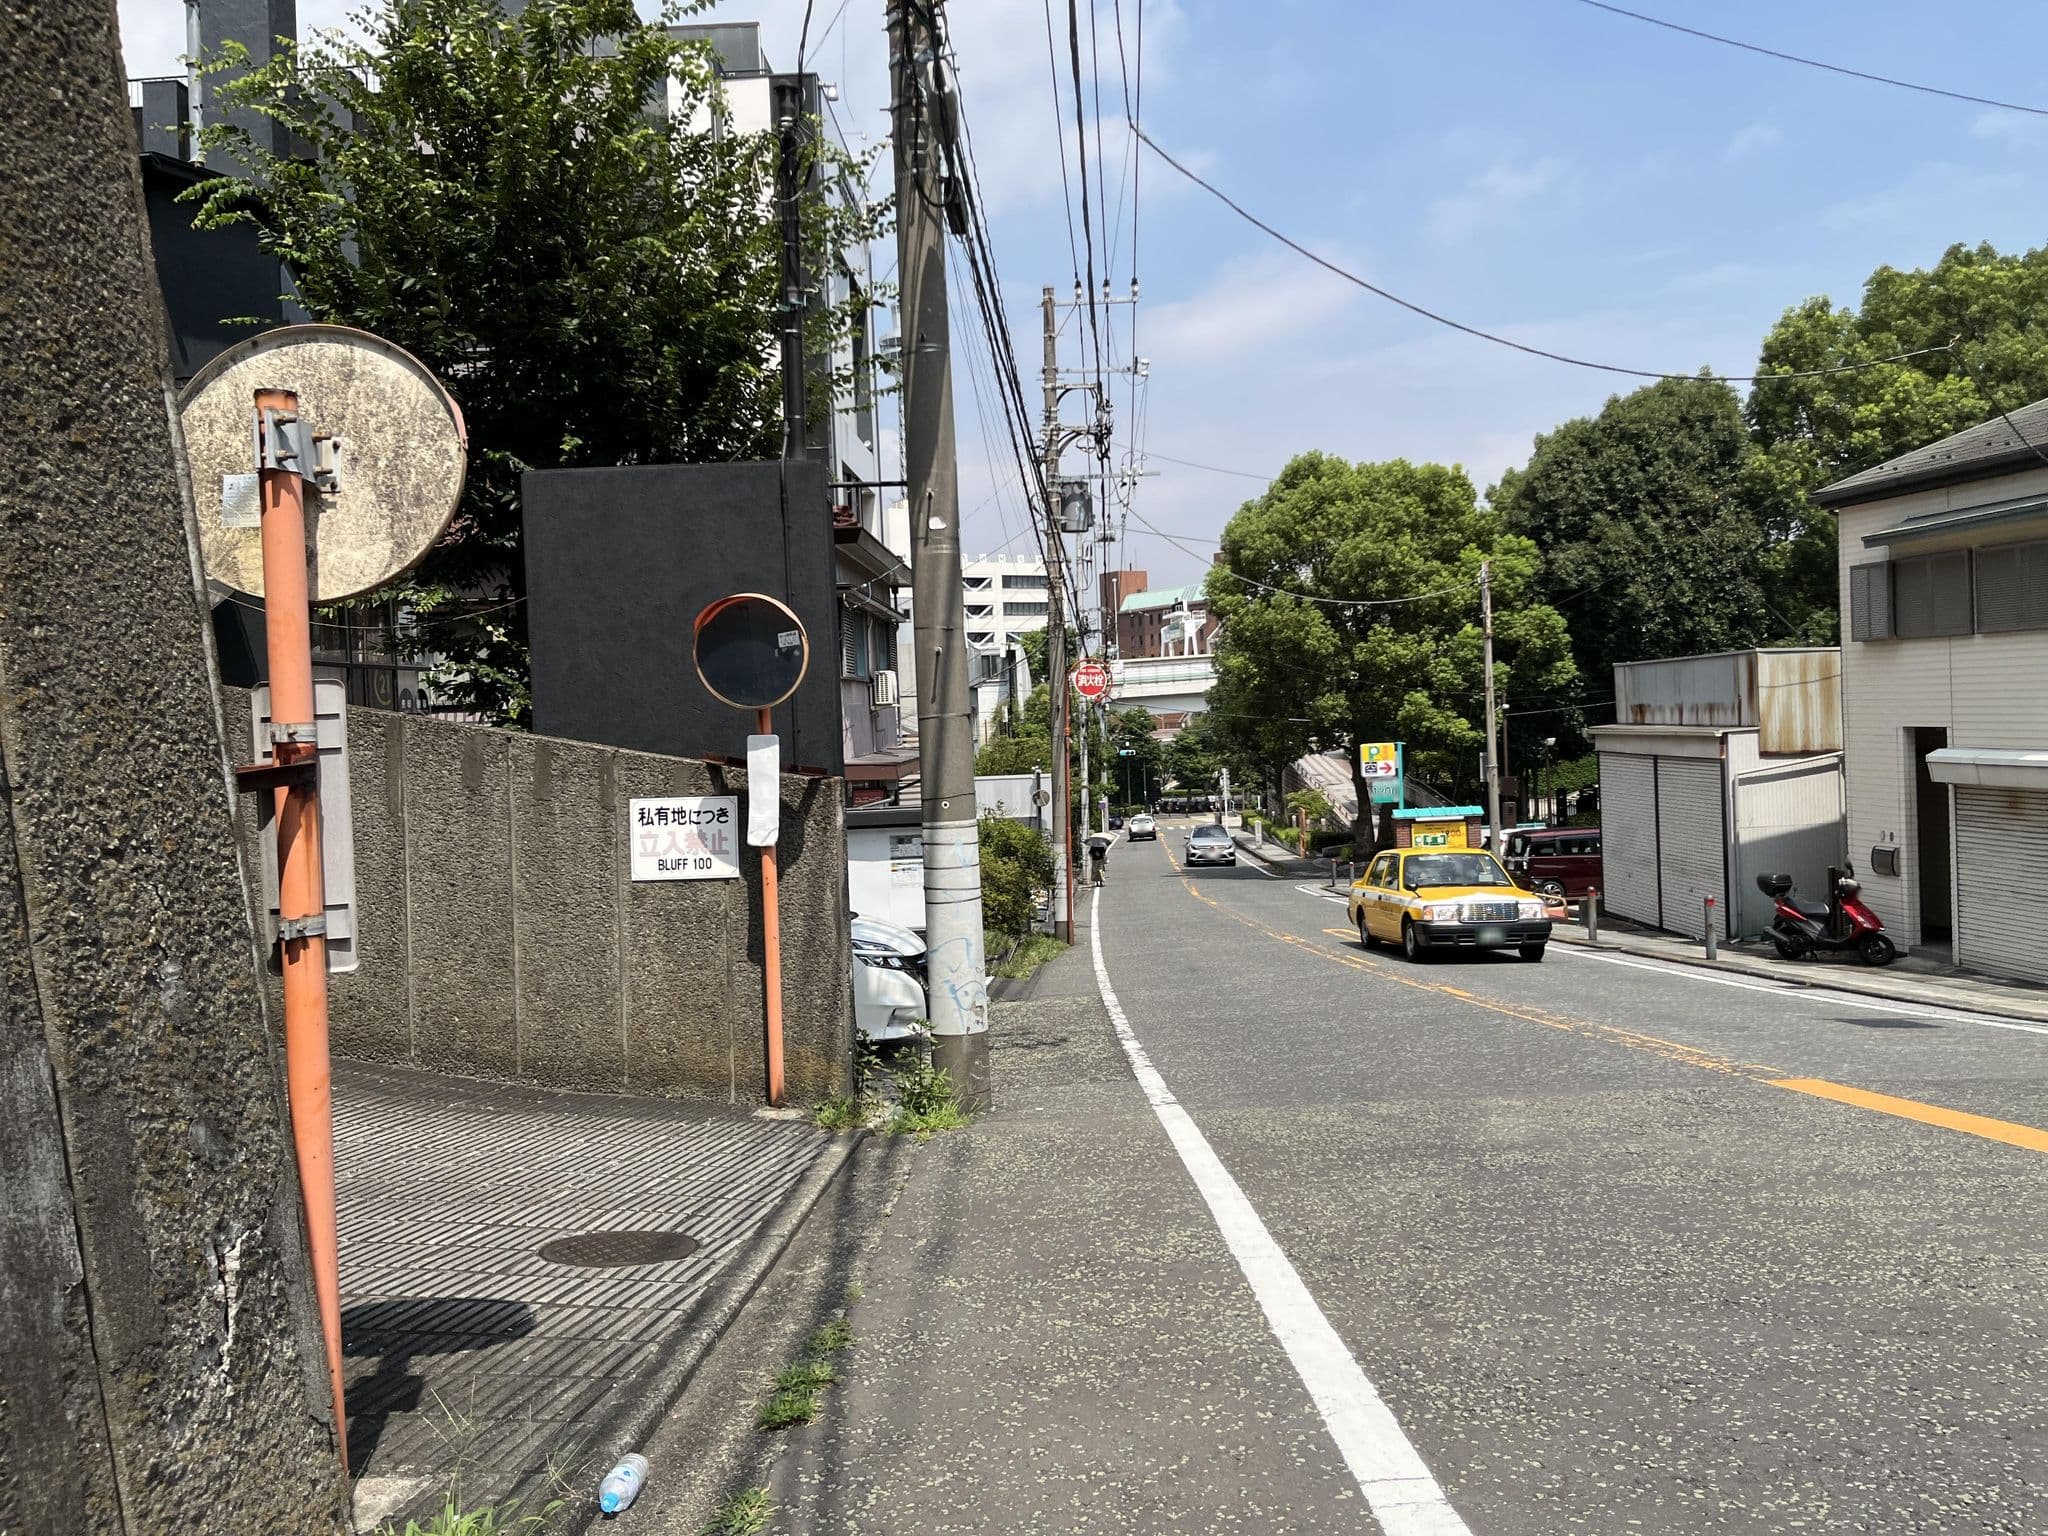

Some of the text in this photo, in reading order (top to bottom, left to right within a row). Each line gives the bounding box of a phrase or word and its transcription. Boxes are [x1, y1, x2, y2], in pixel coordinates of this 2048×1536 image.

[1077, 674, 1104, 687] 消火栓
[638, 806, 729, 826] 私有地につき
[639, 828, 729, 857] 立入禁止
[658, 857, 712, 871] BLUFF 100
